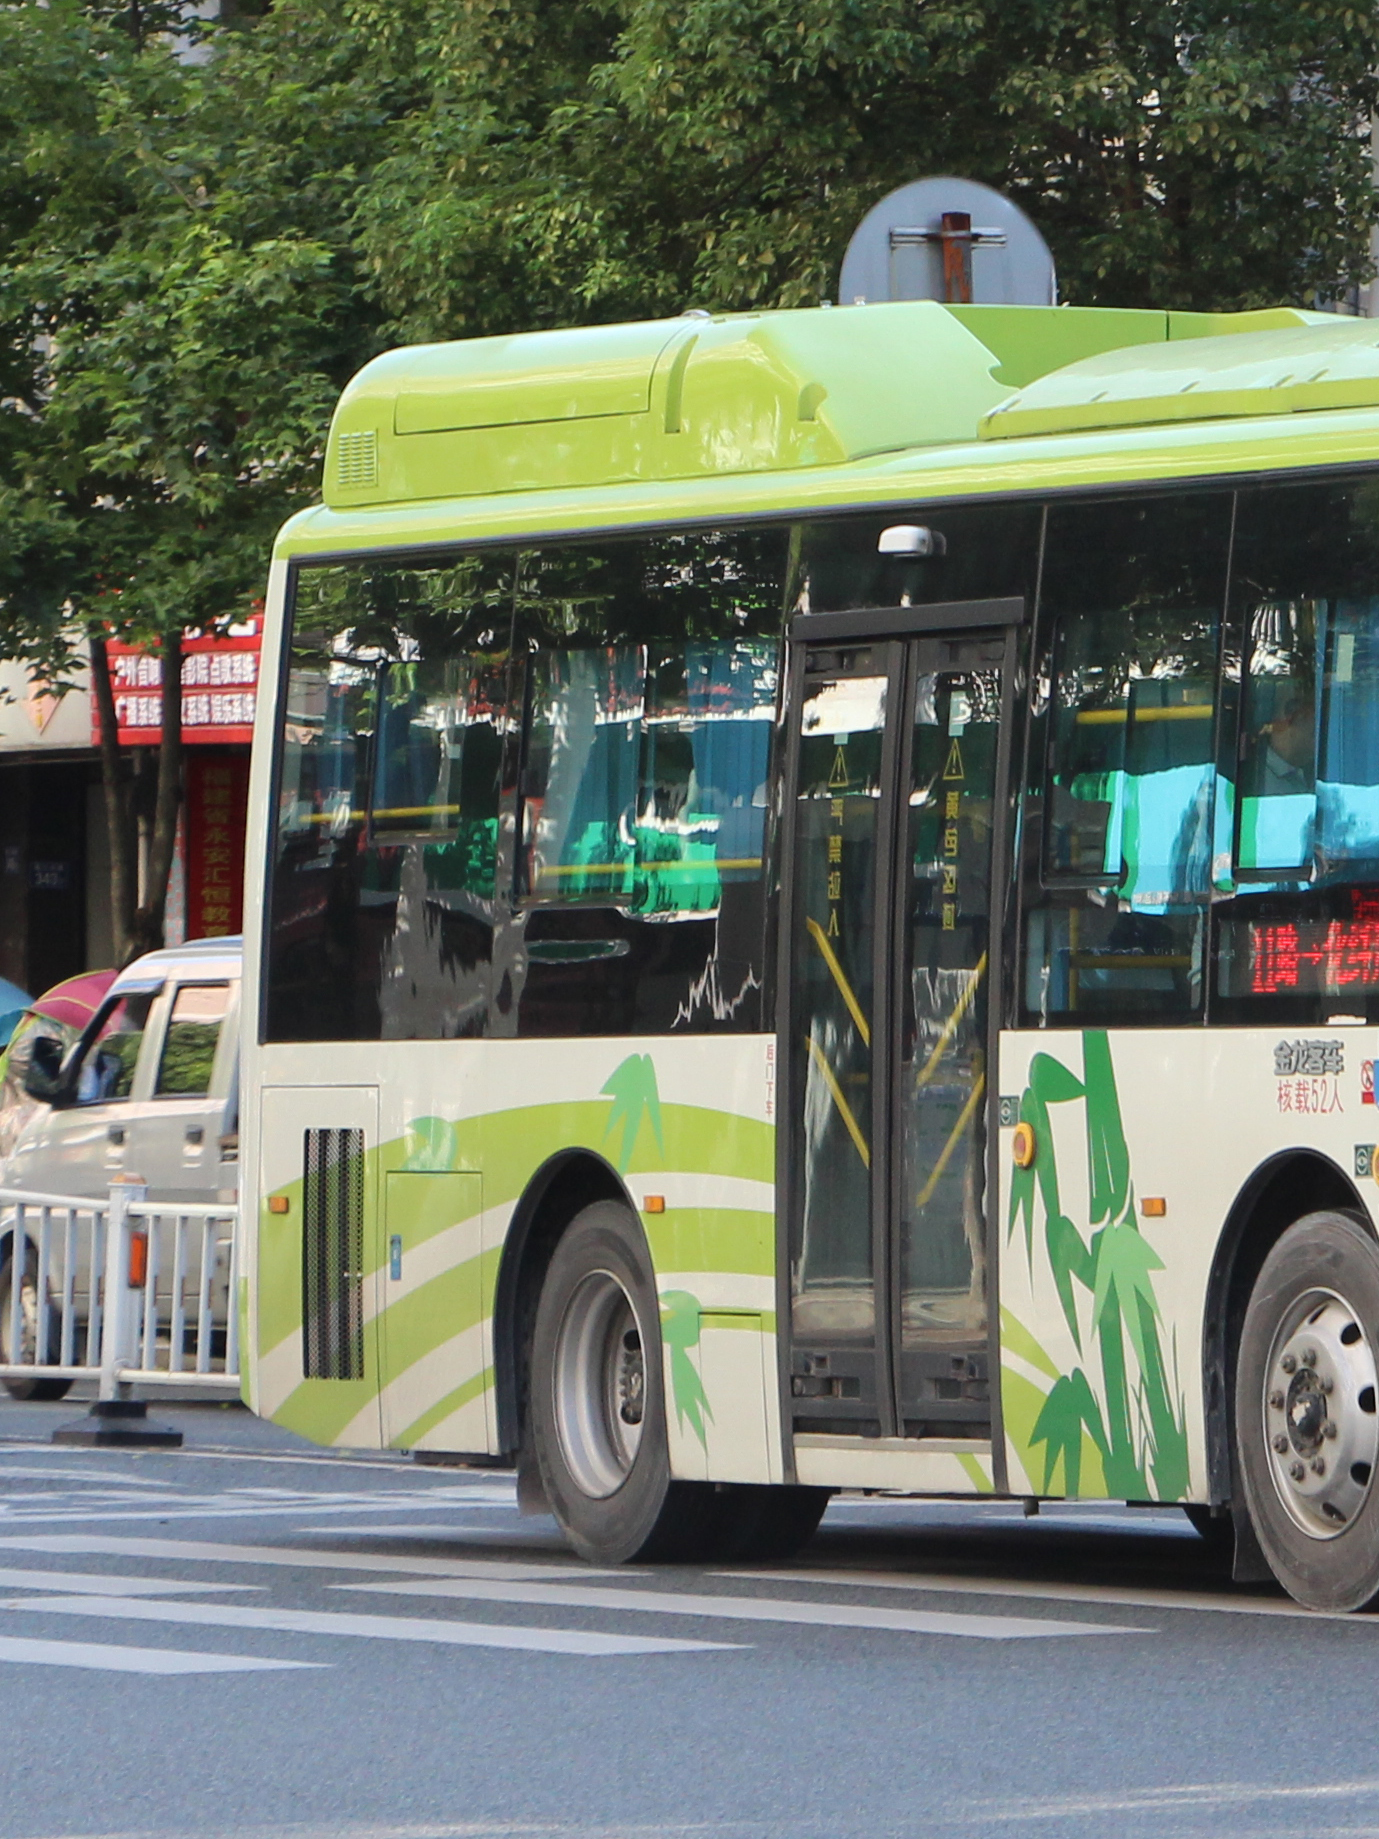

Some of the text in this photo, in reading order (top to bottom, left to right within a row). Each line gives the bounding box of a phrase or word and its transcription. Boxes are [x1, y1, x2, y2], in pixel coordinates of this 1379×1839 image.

[1273, 1039, 1345, 1076] 金龙客车
[1276, 1078, 1345, 1114] 核载52人
